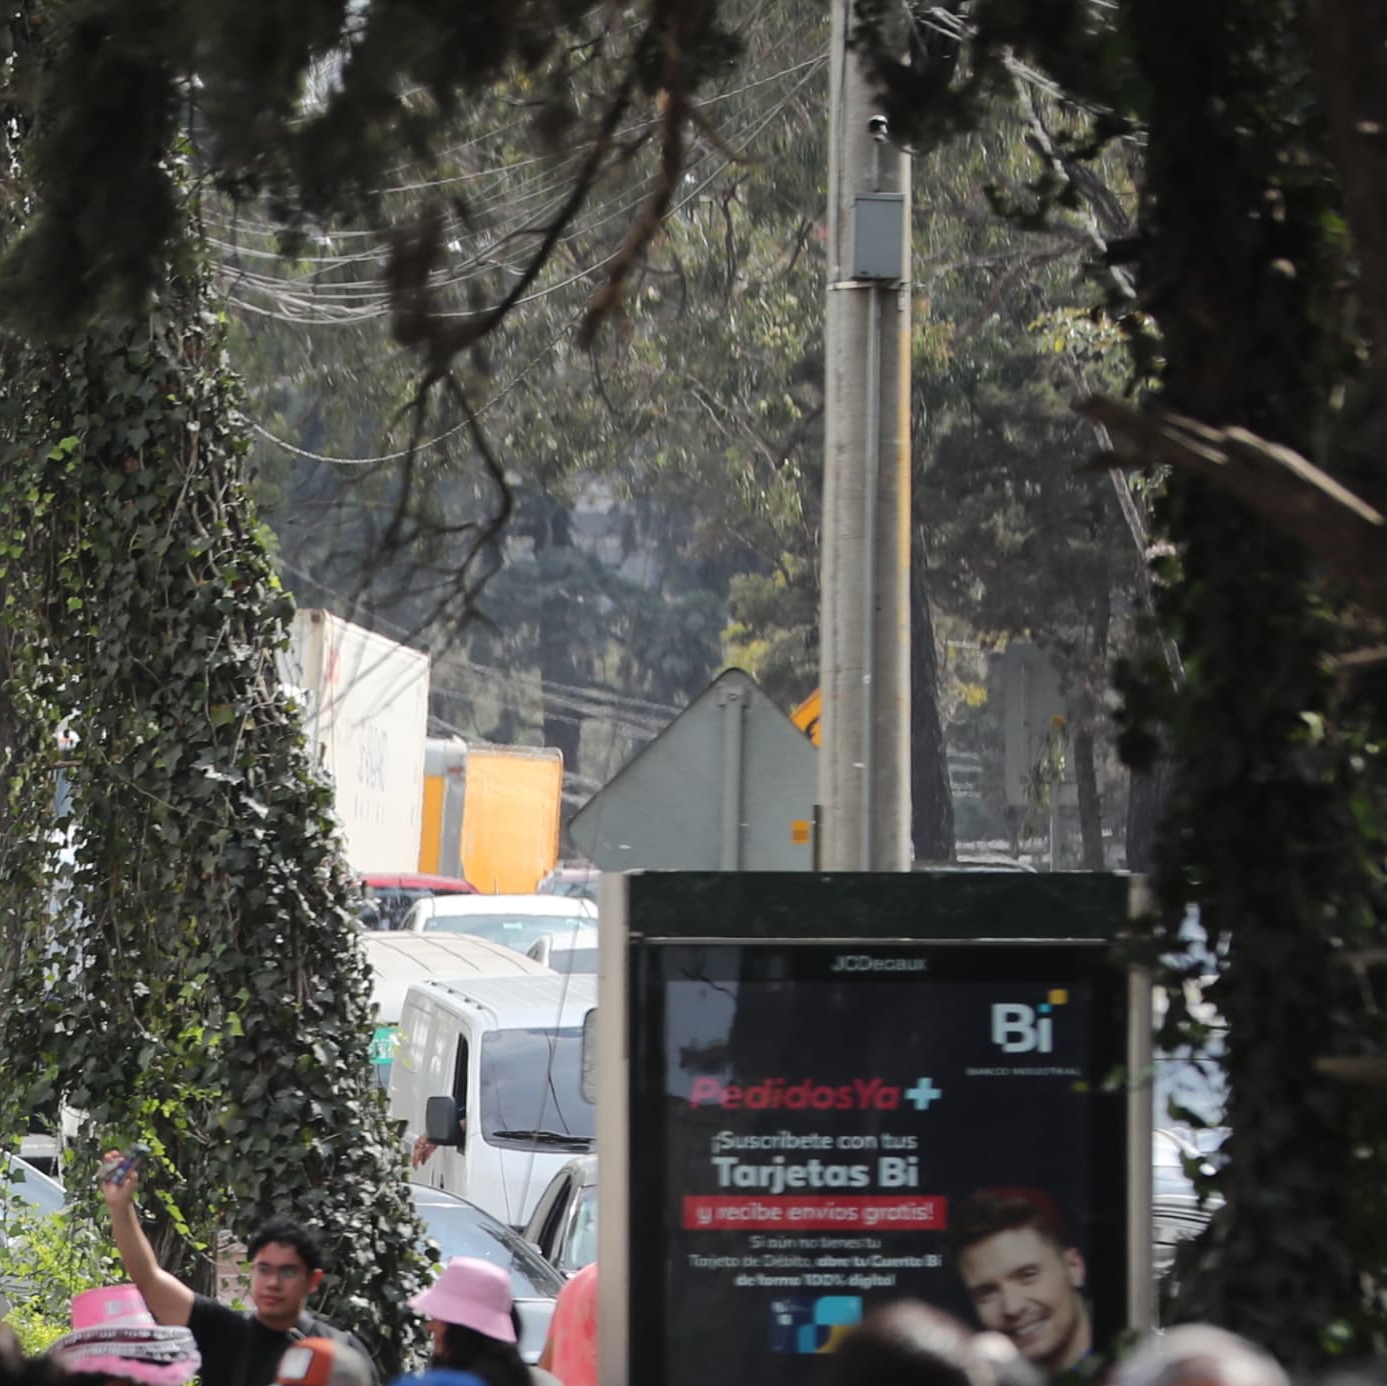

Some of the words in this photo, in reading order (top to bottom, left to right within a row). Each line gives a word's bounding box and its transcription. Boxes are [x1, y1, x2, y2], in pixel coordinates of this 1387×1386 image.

[829, 954, 927, 972] JCDecaux
[991, 1002, 1053, 1053] Bi
[836, 1136, 877, 1149] con
[880, 1133, 918, 1149] tus
[711, 1156, 869, 1194] Tarjetas
[877, 1156, 919, 1187] Bi
[696, 1207, 712, 1225] y
[716, 1202, 781, 1220] recibe
[786, 1201, 857, 1220] envíos
[862, 1202, 934, 1225] gratis!
